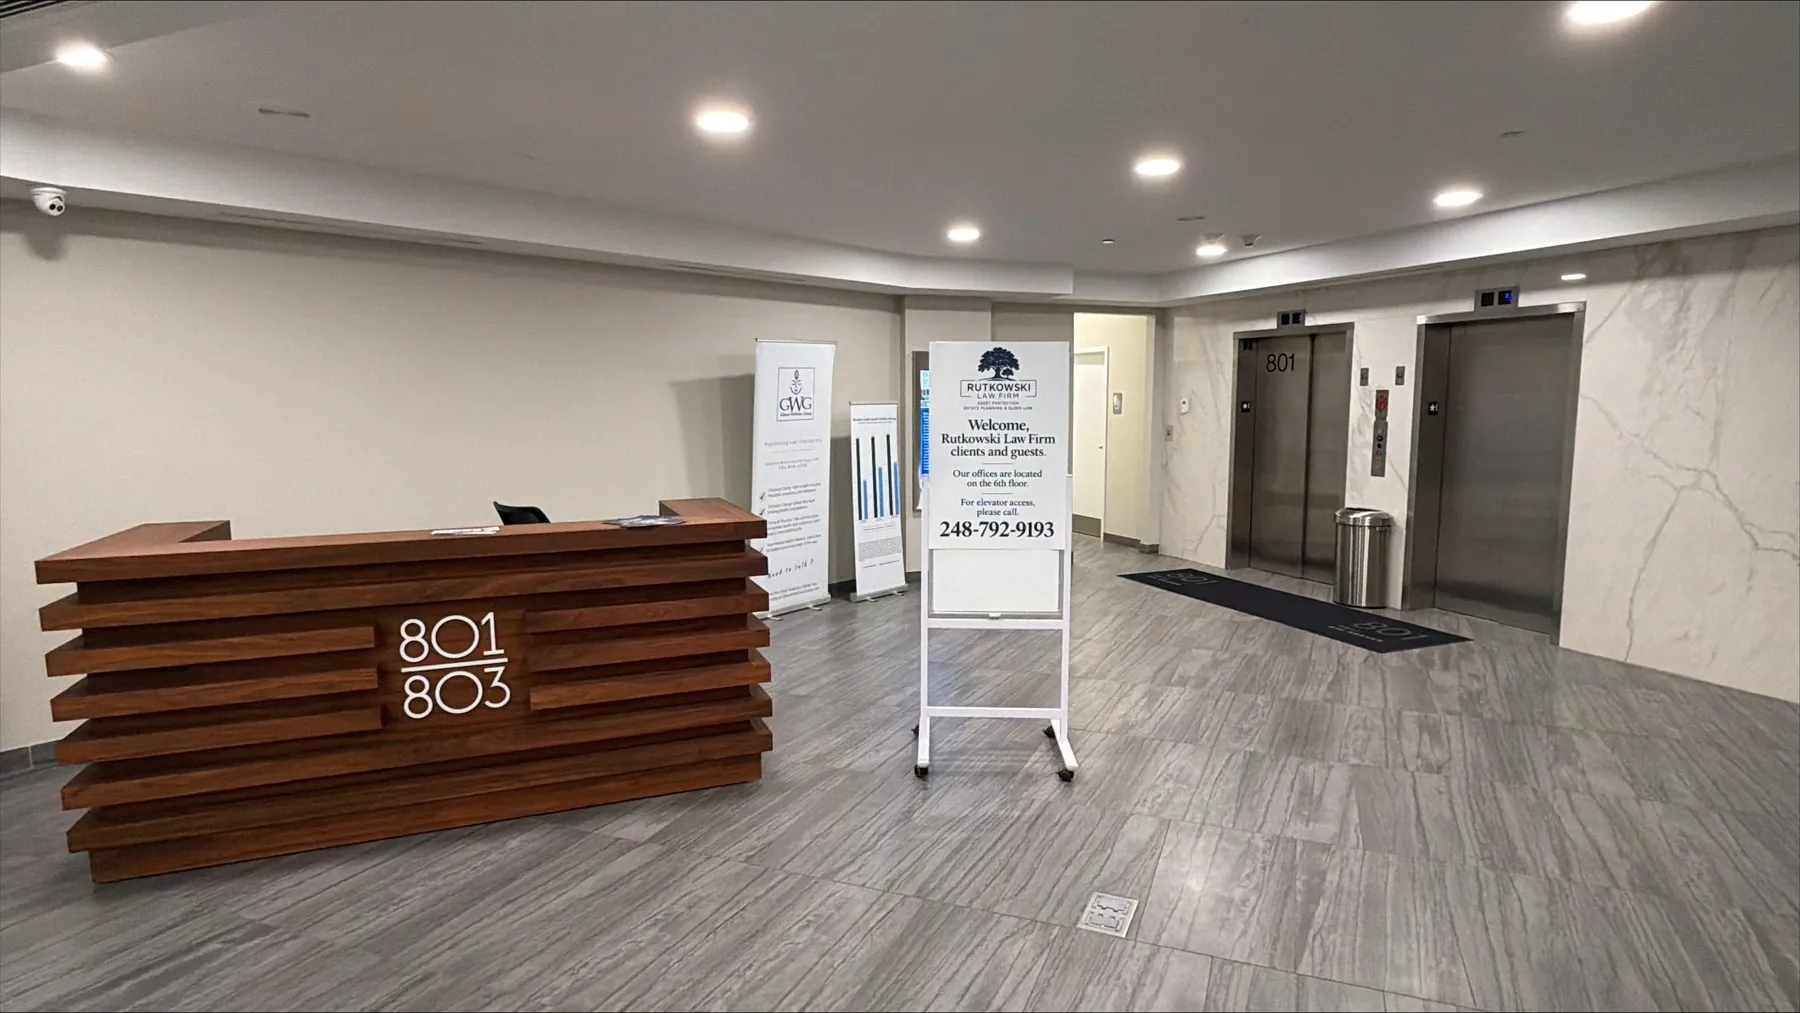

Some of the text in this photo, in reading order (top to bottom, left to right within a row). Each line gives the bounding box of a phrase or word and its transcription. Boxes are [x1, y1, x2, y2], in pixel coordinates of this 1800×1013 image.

[1266, 353, 1295, 373] 801
[967, 383, 1031, 392] RUTKOWSKI
[779, 396, 812, 412] GWG
[968, 419, 1030, 432] Welcome,
[941, 433, 1056, 444] Rutkowski Law Firm
[950, 446, 1047, 460] clients and guests.
[953, 469, 970, 478] Our
[972, 469, 998, 478] offices
[1014, 469, 1043, 478] located
[979, 479, 992, 487] the
[993, 479, 1006, 487] 6th
[1008, 479, 1029, 488] floor.
[960, 498, 1036, 508] For elevator access,
[977, 508, 1019, 518] please call.
[939, 521, 1055, 538] 248-792-9193
[399, 611, 505, 663] 801
[403, 665, 511, 719] 803
